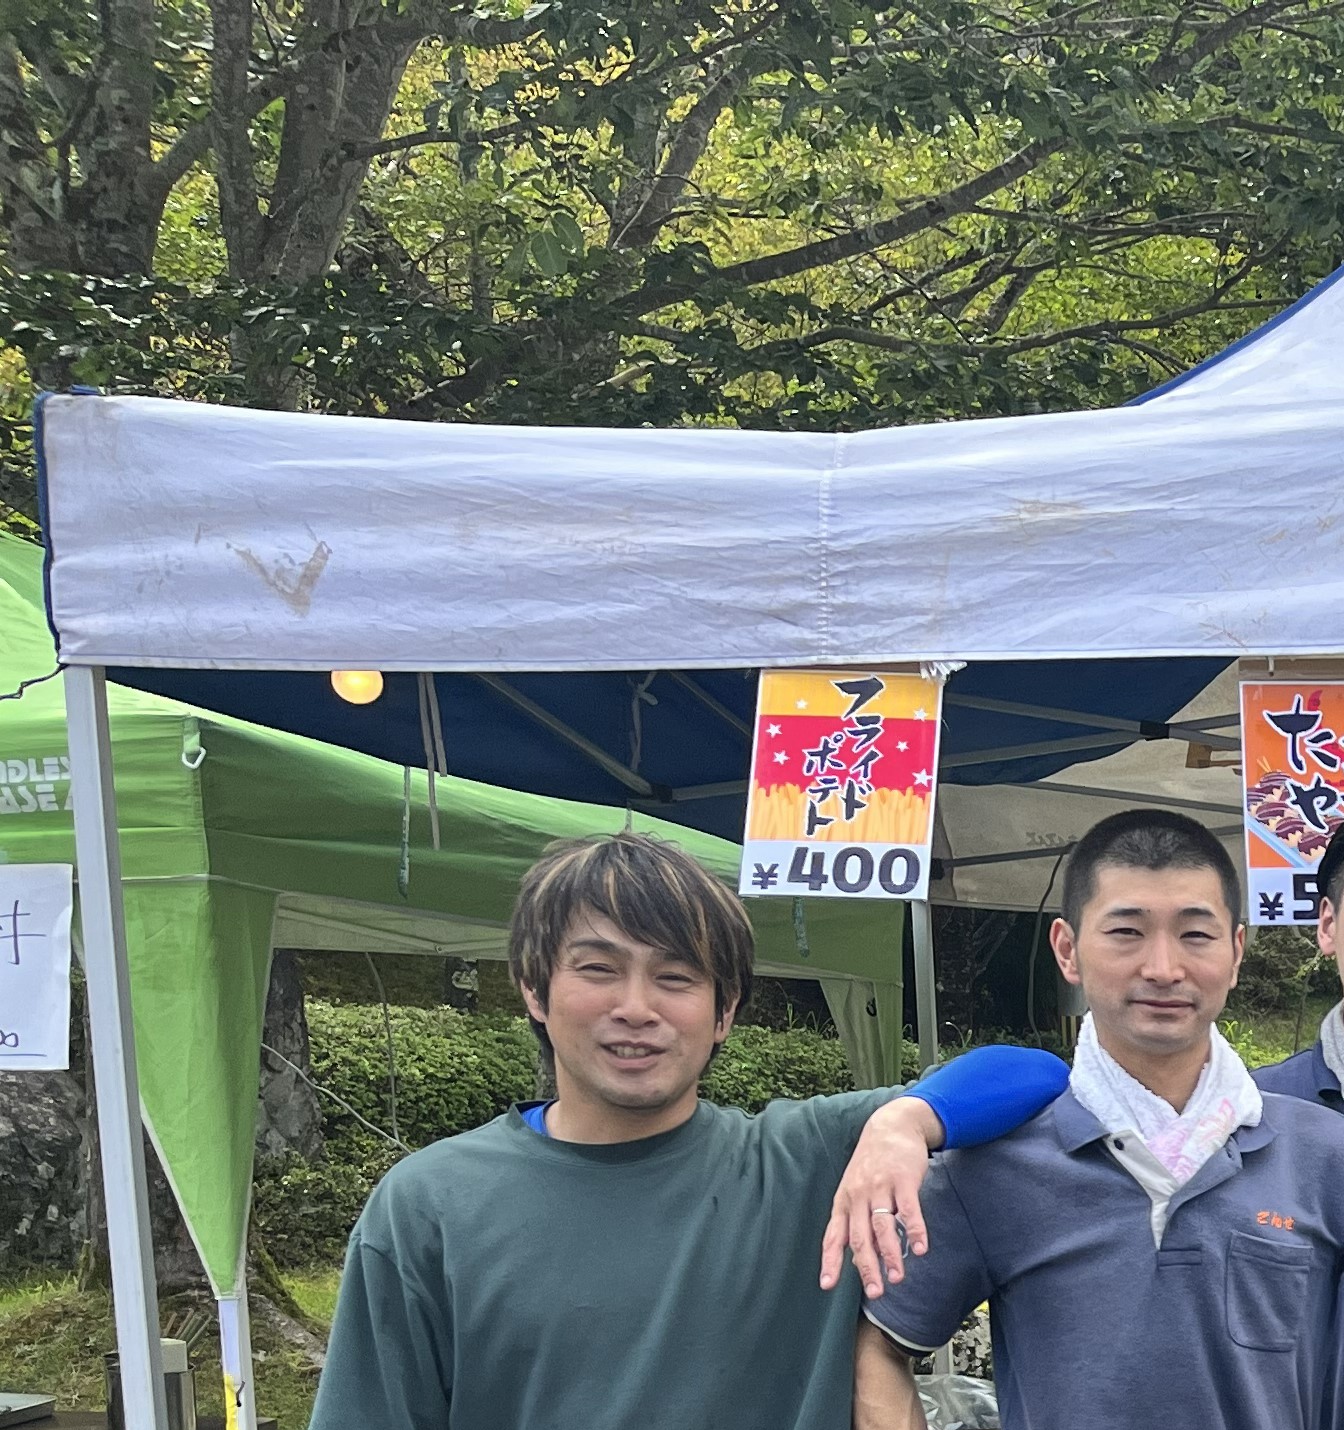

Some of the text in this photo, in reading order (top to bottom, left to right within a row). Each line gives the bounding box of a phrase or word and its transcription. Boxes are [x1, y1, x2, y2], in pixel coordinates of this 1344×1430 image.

[804, 733, 845, 836] ポテト
[833, 676, 885, 821] フライド
[751, 846, 921, 895] ¥400
